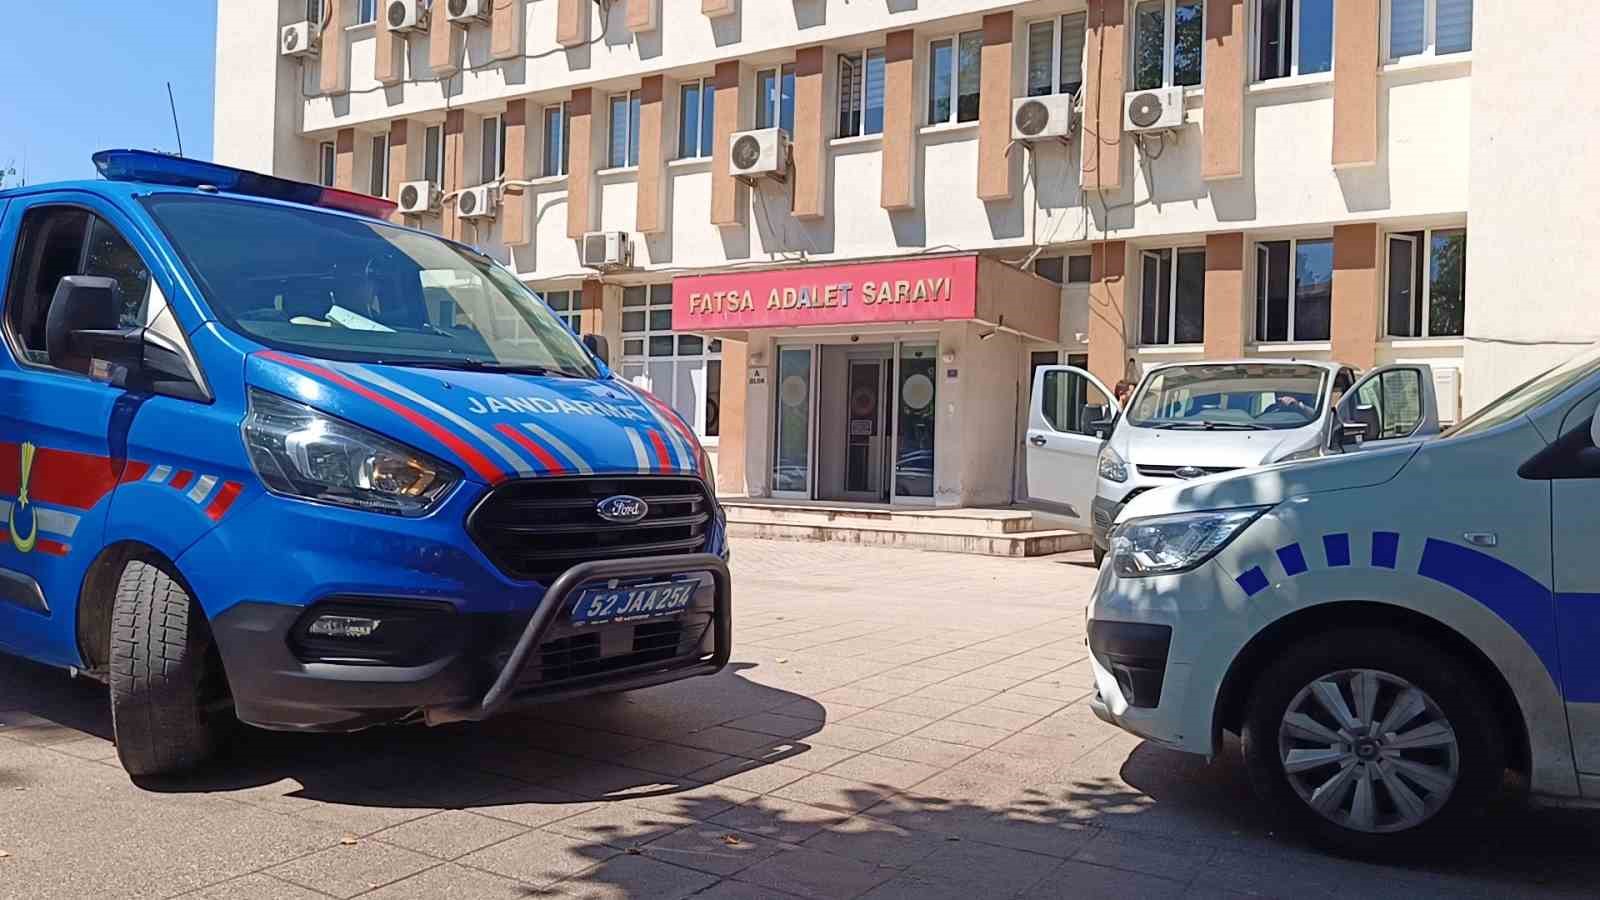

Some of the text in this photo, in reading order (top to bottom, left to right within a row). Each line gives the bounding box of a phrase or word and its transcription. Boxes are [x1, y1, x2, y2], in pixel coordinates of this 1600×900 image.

[689, 278, 953, 315] FATSA ADALET SARAYI
[467, 396, 647, 422] JANDARMA
[612, 500, 640, 516] Ford
[586, 594, 619, 616] 52
